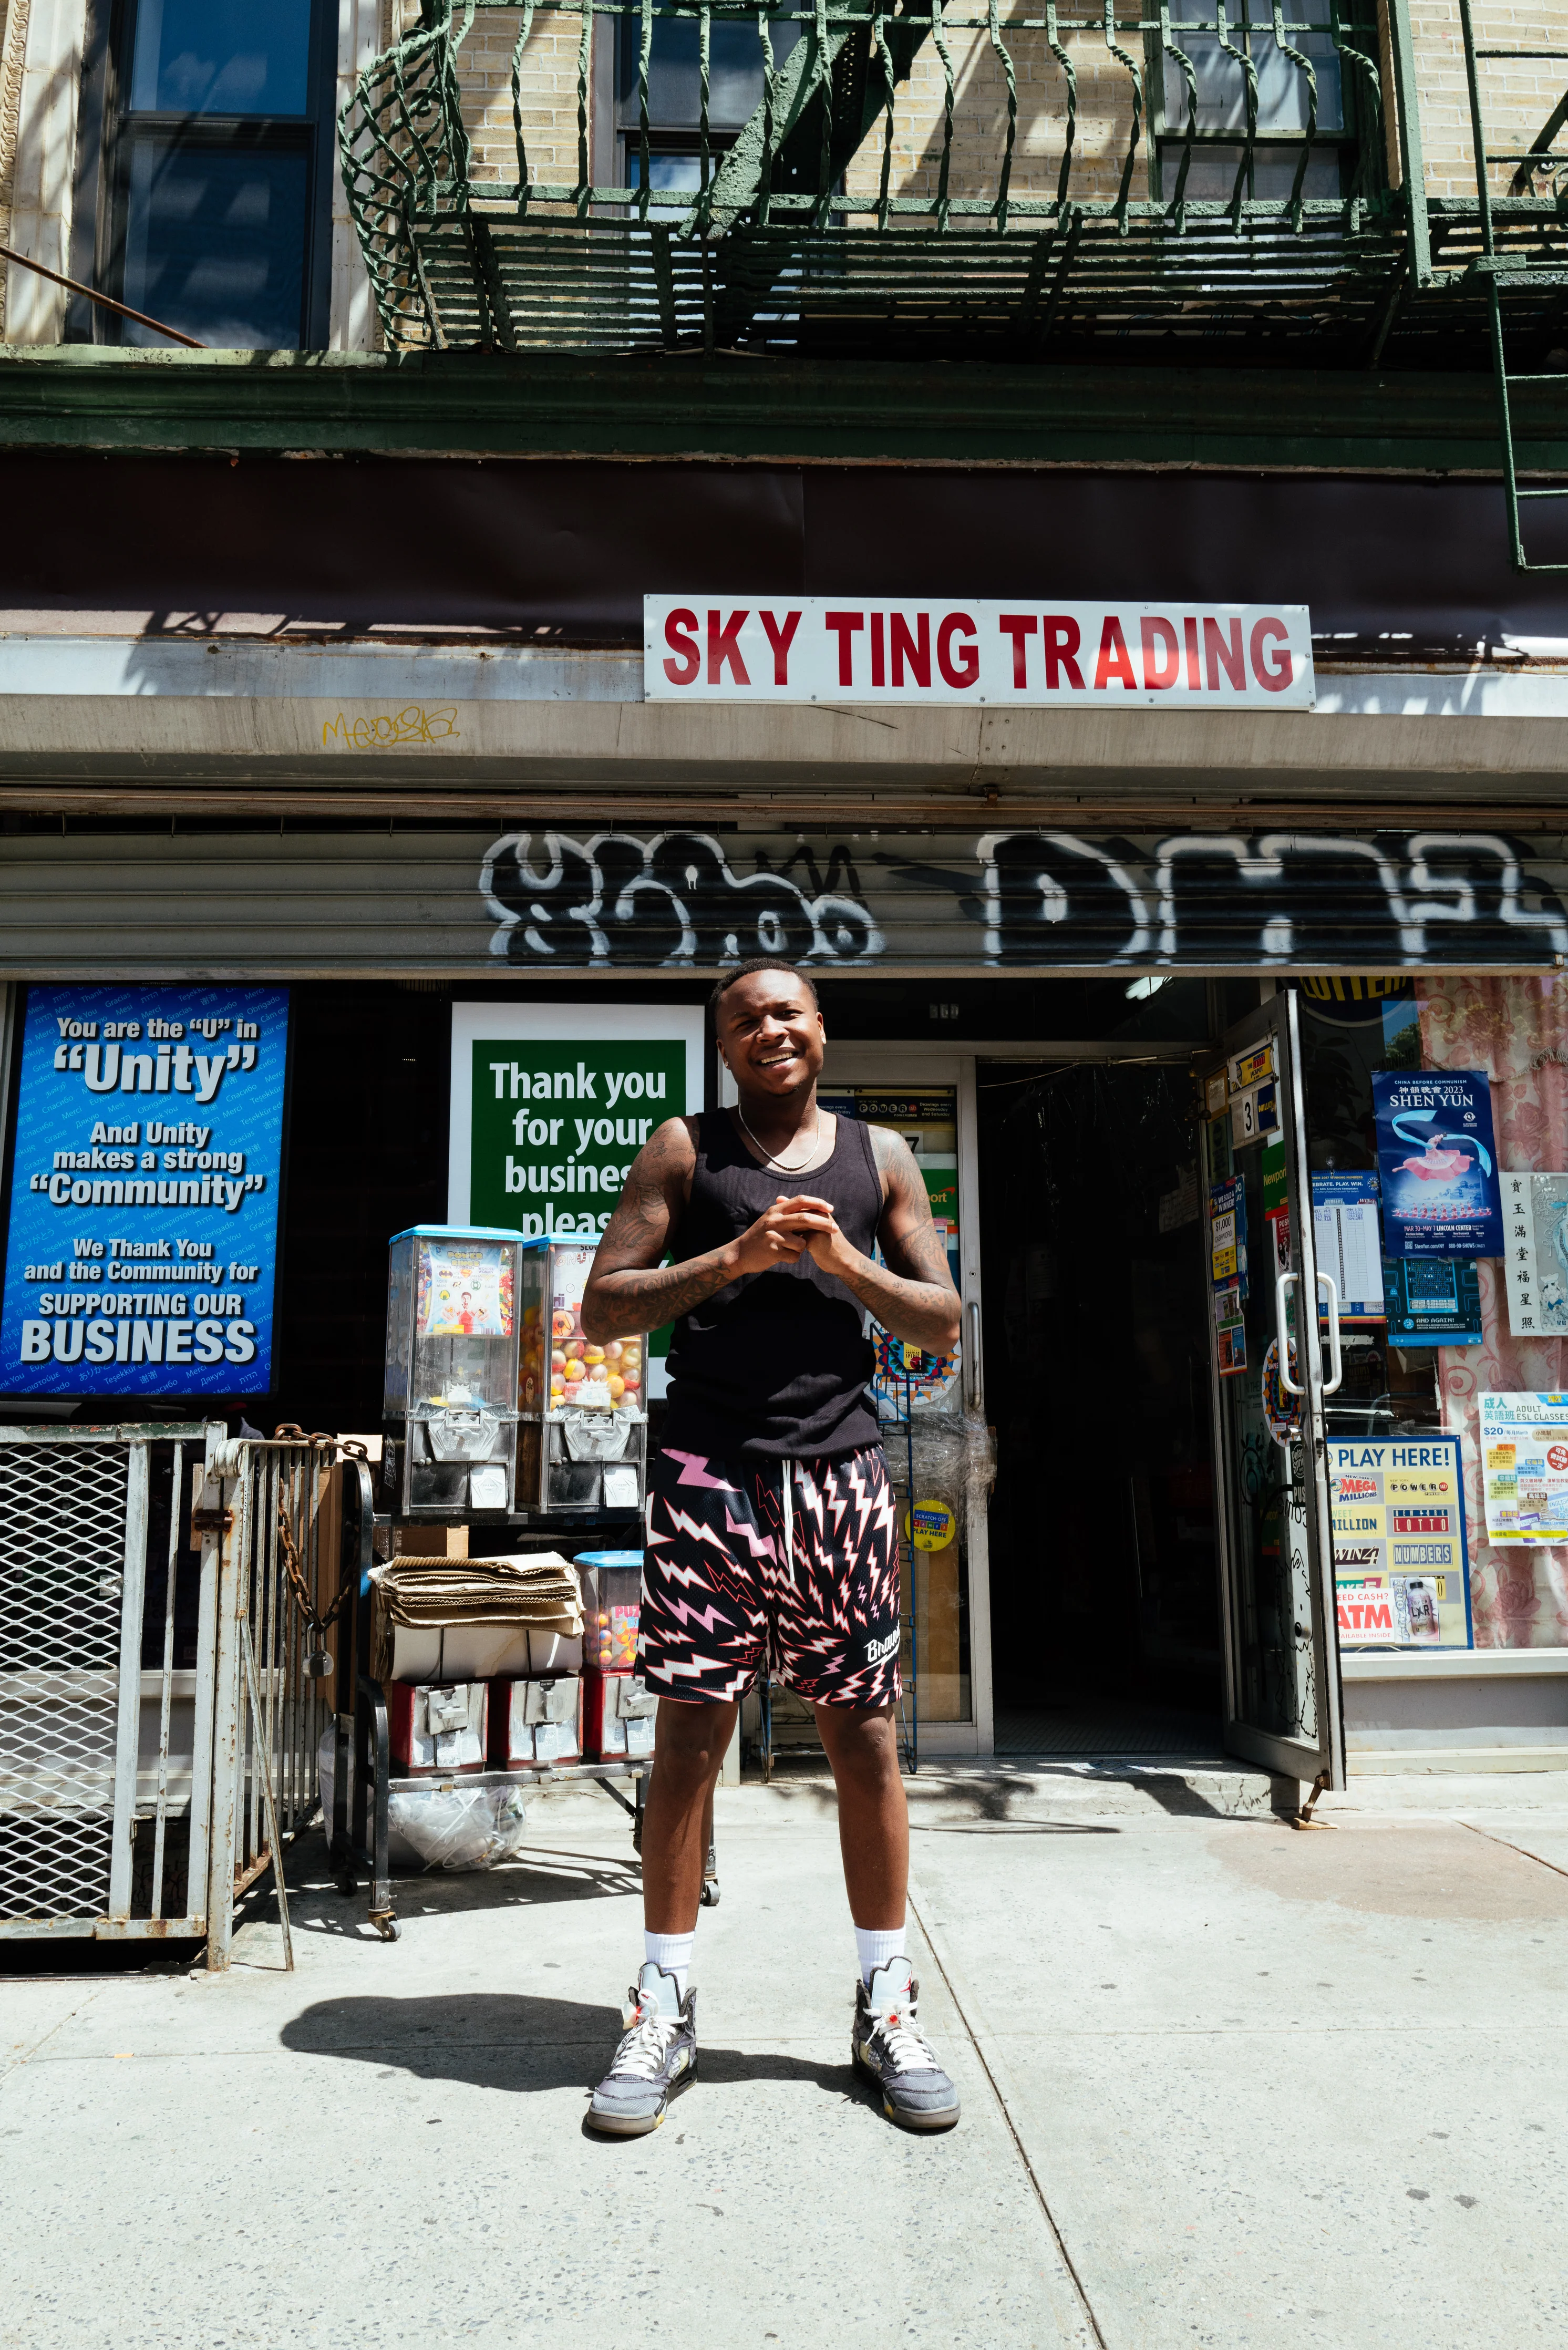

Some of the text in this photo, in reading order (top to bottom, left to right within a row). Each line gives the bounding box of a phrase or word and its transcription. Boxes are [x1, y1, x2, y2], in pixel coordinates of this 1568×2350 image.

[662, 608, 1293, 692] SKY TING TRADING
[206, 1002, 237, 1019] Спасибо
[57, 1017, 96, 1037] You
[104, 1022, 140, 1037] are
[147, 1018, 183, 1038] the
[236, 1019, 257, 1038] in
[54, 1044, 255, 1101] “Unity”
[1250, 1066, 1263, 1078] JACKPOT
[226, 1084, 257, 1102] Спасибо
[489, 1062, 666, 1109] Thank you
[1399, 1086, 1441, 1094] 神韻晚會
[1390, 1094, 1473, 1107] SHEN YUN
[1244, 1101, 1252, 1131] 3
[22, 1121, 54, 1139] Спасибо
[90, 1122, 210, 1148] And Unity
[512, 1108, 653, 1156] for your
[53, 1147, 243, 1174] makes a strong
[30, 1173, 263, 1211] “Community”
[1218, 1199, 1235, 1213] WINNER!
[103, 1222, 135, 1241] Спасибо
[1215, 1216, 1231, 1232] $1,000
[73, 1239, 211, 1257] We Thank You
[447, 1251, 483, 1260] POWER
[24, 1261, 257, 1284] and the Community for
[39, 1293, 242, 1315] SUPPORTING OUR
[20, 1320, 254, 1362] BUSINESS
[139, 1370, 158, 1385] 谢谢
[1484, 1397, 1507, 1409] 成人
[1484, 1410, 1515, 1420] 英語班
[1338, 1448, 1450, 1467] PLAY HERE!
[1294, 1486, 1305, 1502] PUS
[1339, 1478, 1377, 1494] MEGA
[1339, 1492, 1377, 1502] MILLIONS
[916, 1513, 947, 1522] SCRATCH-OFF
[1396, 1519, 1446, 1531] LOTTO
[1394, 1546, 1450, 1563] NUMBERS
[1337, 1604, 1392, 1630] ATM
